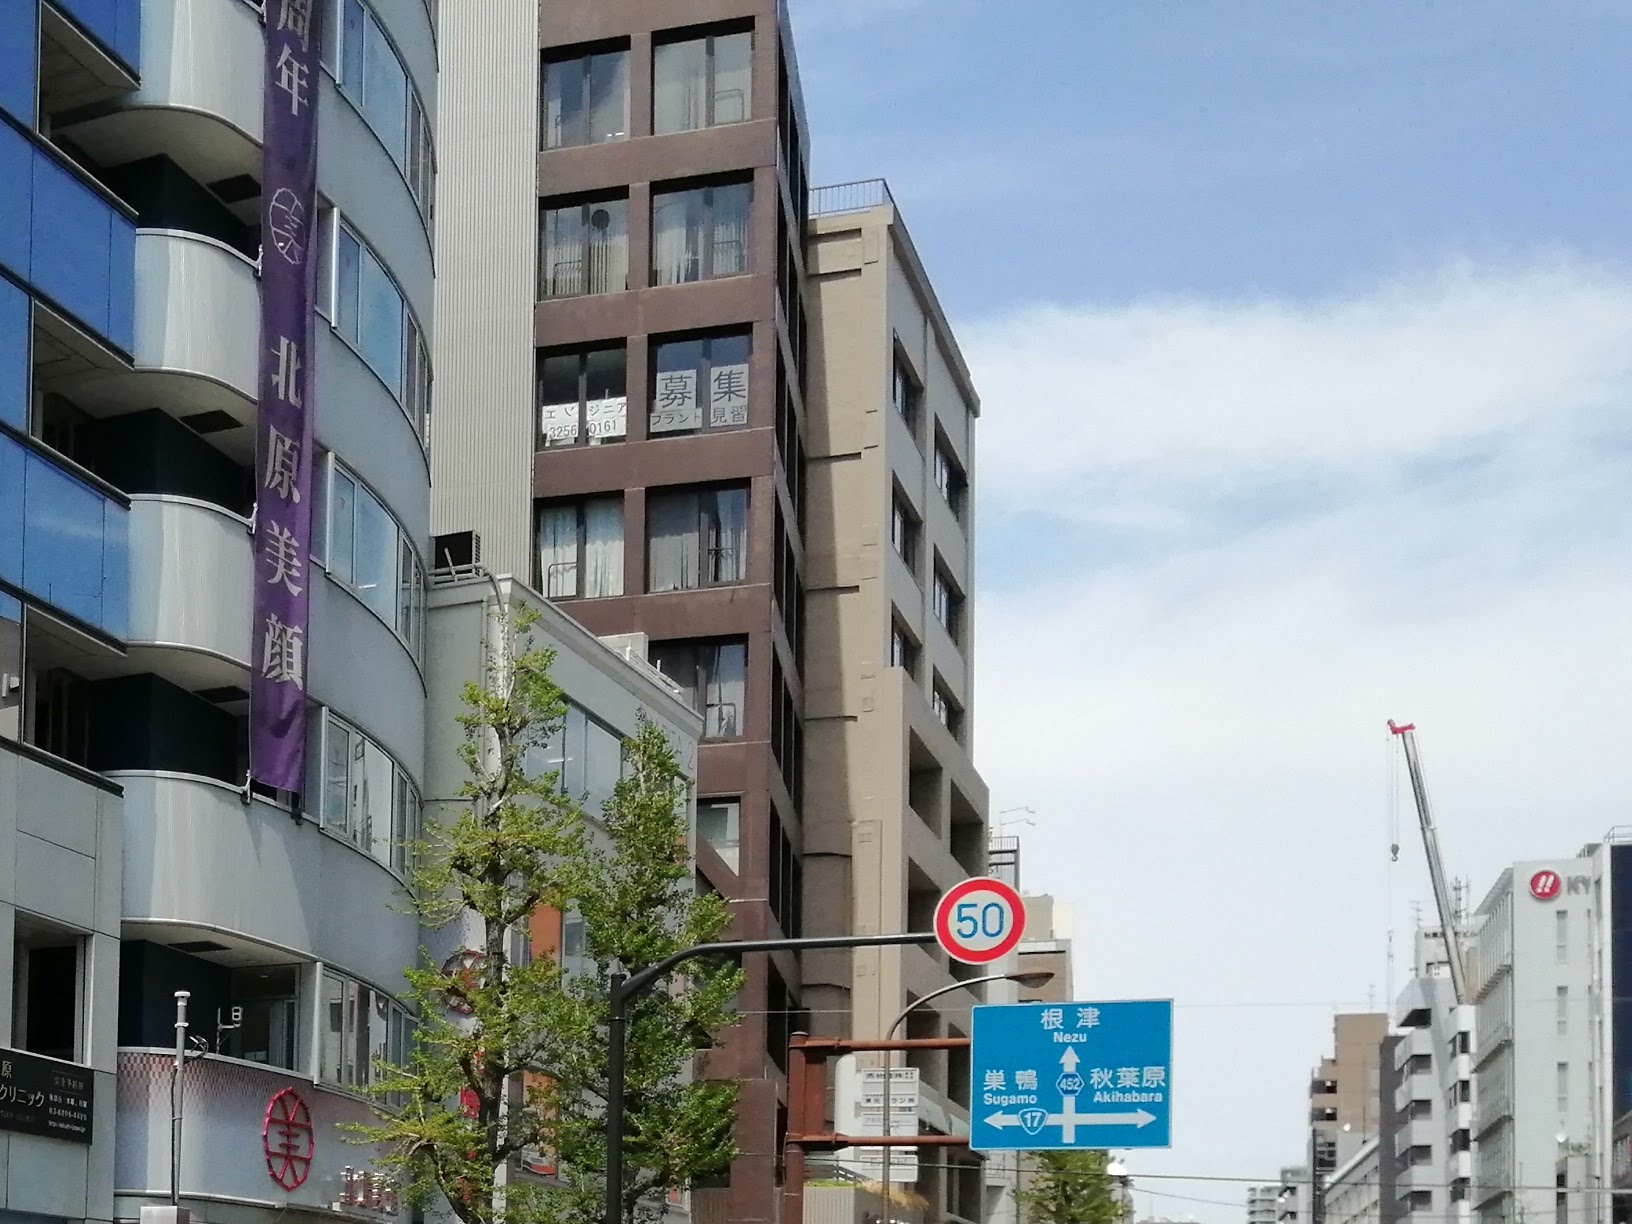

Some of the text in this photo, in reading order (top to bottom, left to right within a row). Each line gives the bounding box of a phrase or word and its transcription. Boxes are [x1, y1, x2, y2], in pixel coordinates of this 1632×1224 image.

[660, 370, 746, 408] 募集
[549, 419, 617, 439] 3256 0161
[262, 335, 304, 692] 北原美顔
[956, 902, 1005, 939] 50
[1040, 1007, 1101, 1030] 根津
[1053, 1031, 1087, 1043] Nezu
[983, 1069, 1038, 1091] 巣鴨
[1059, 1077, 1081, 1091] 452
[1090, 1066, 1166, 1089] 秋葉原
[983, 1093, 1038, 1107] Sugamo
[1093, 1091, 1163, 1103] Akihabara
[1023, 1111, 1043, 1129] 17
